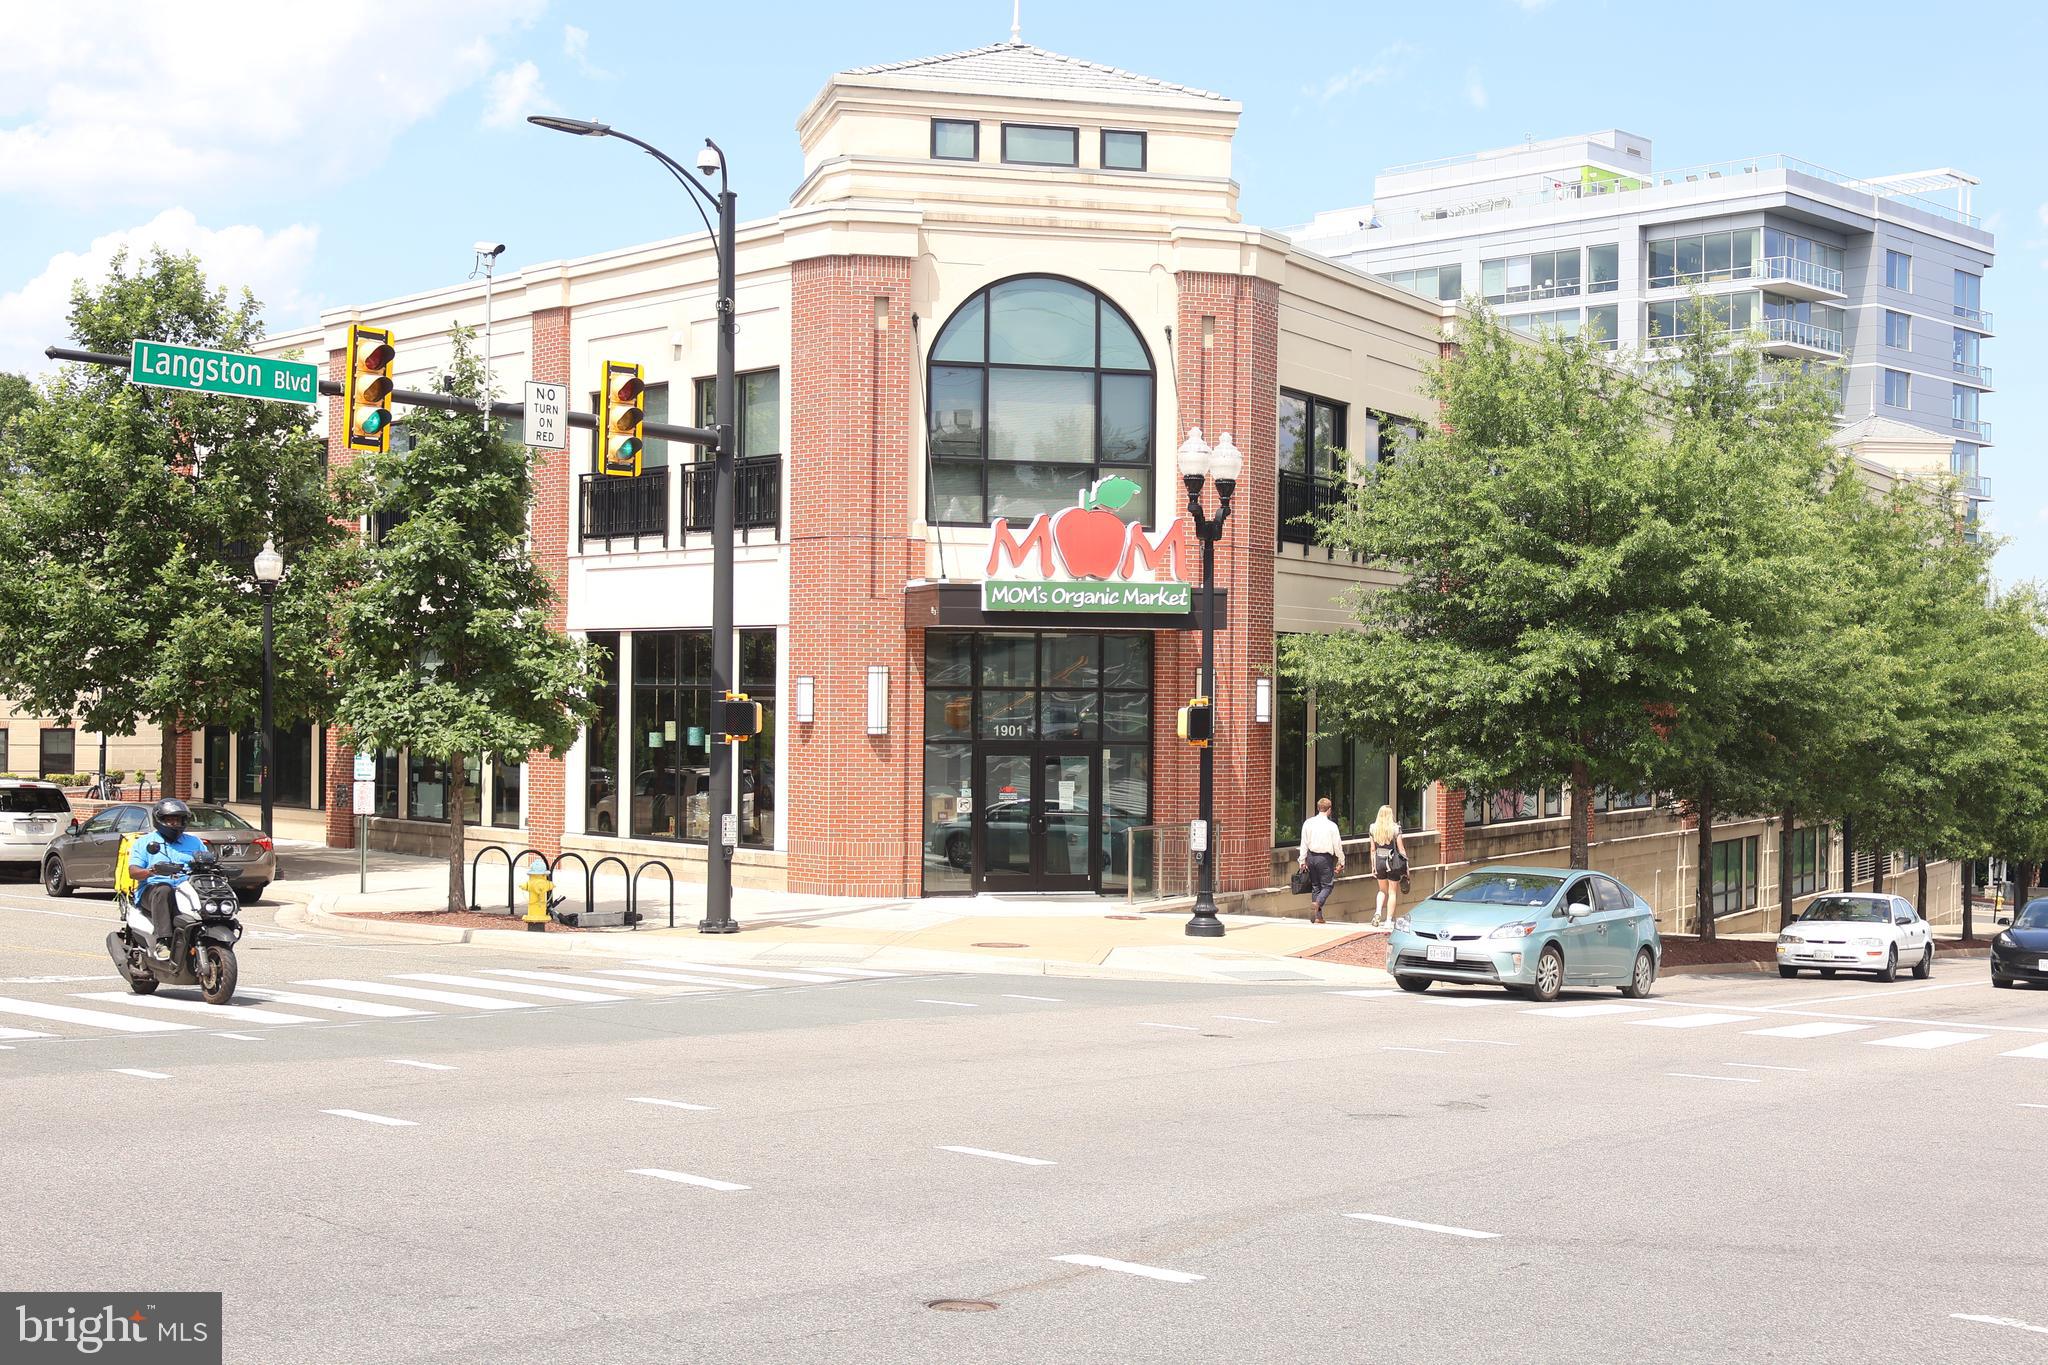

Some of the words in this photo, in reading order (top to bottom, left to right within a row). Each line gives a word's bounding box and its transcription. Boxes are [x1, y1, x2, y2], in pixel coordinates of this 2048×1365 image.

[141, 346, 262, 387] Langston
[274, 370, 311, 393] Blvd
[536, 387, 556, 401] NO
[534, 402, 559, 415] TURN
[539, 417, 553, 428] ON
[536, 431, 554, 442] RED
[991, 585, 1048, 604] MOM's
[1051, 587, 1117, 607] Organic
[1122, 588, 1188, 606] Market
[993, 724, 1023, 737] 1901
